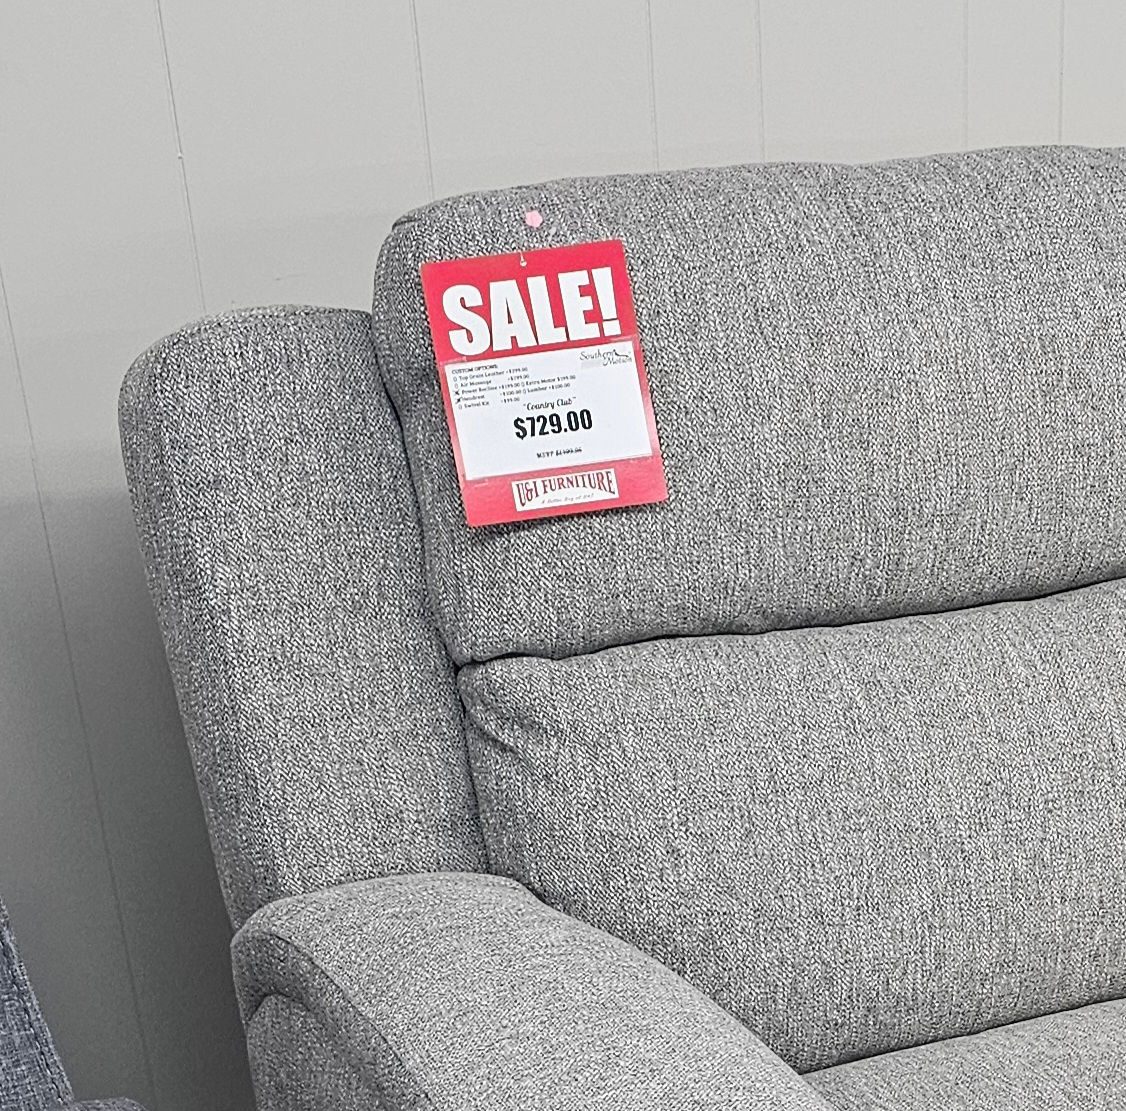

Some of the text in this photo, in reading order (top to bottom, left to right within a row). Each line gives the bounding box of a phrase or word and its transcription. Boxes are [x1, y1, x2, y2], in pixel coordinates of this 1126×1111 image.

[442, 266, 622, 356] SALE!
[513, 408, 593, 440] $729.00
[516, 481, 540, 507] U&I
[541, 471, 616, 495] FURNITURE
